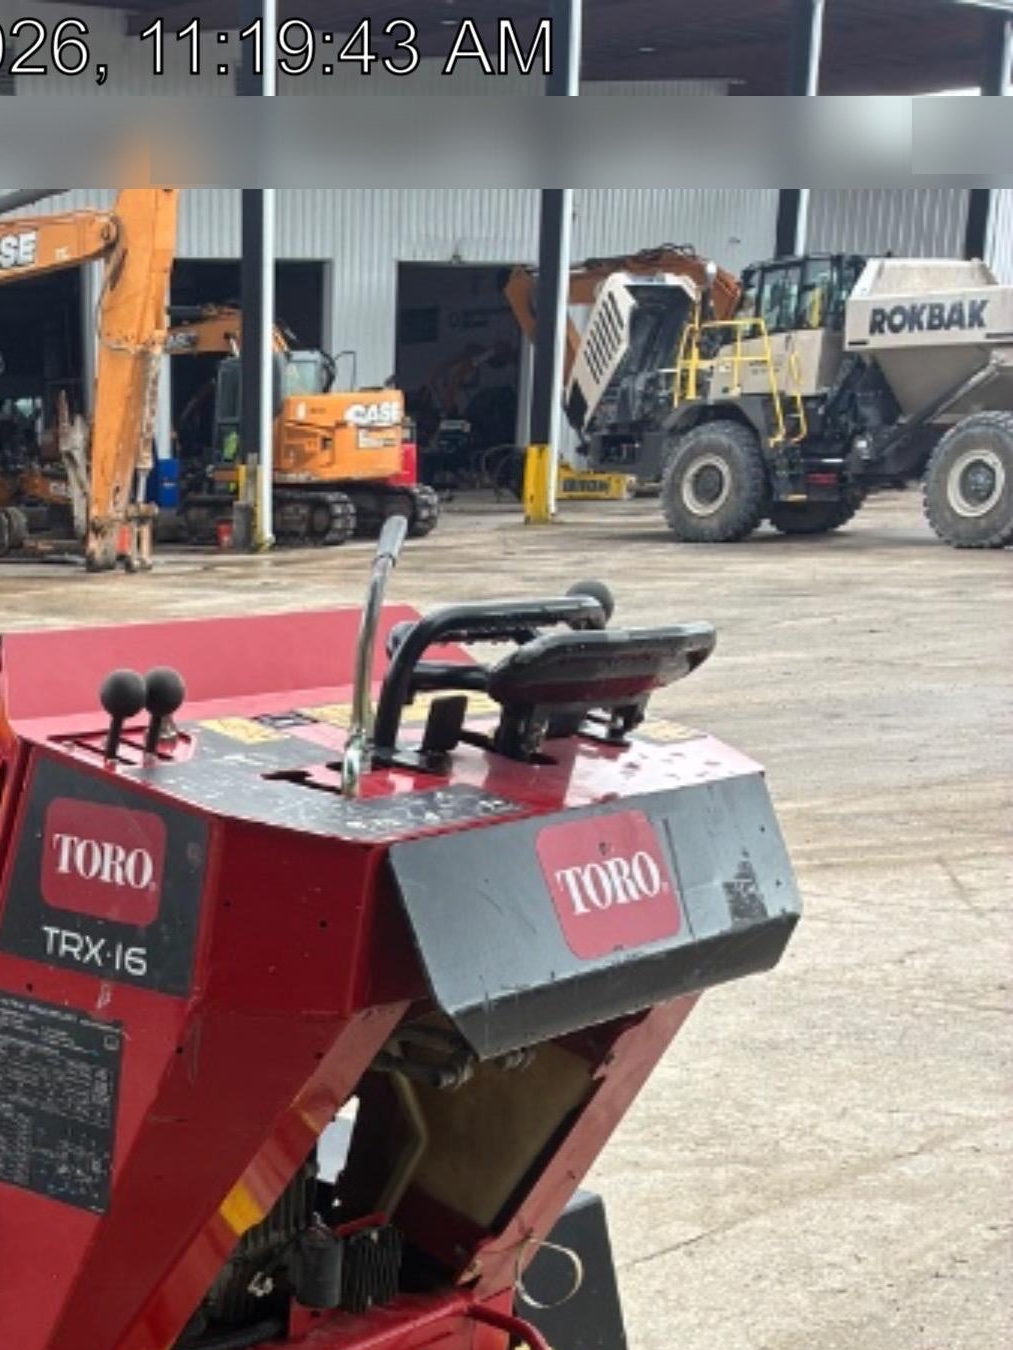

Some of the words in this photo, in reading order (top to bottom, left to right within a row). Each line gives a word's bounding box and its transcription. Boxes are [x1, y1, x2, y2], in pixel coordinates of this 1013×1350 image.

[869, 299, 990, 335] ROKBAK
[52, 833, 154, 890] TORO
[554, 850, 663, 916] TORO
